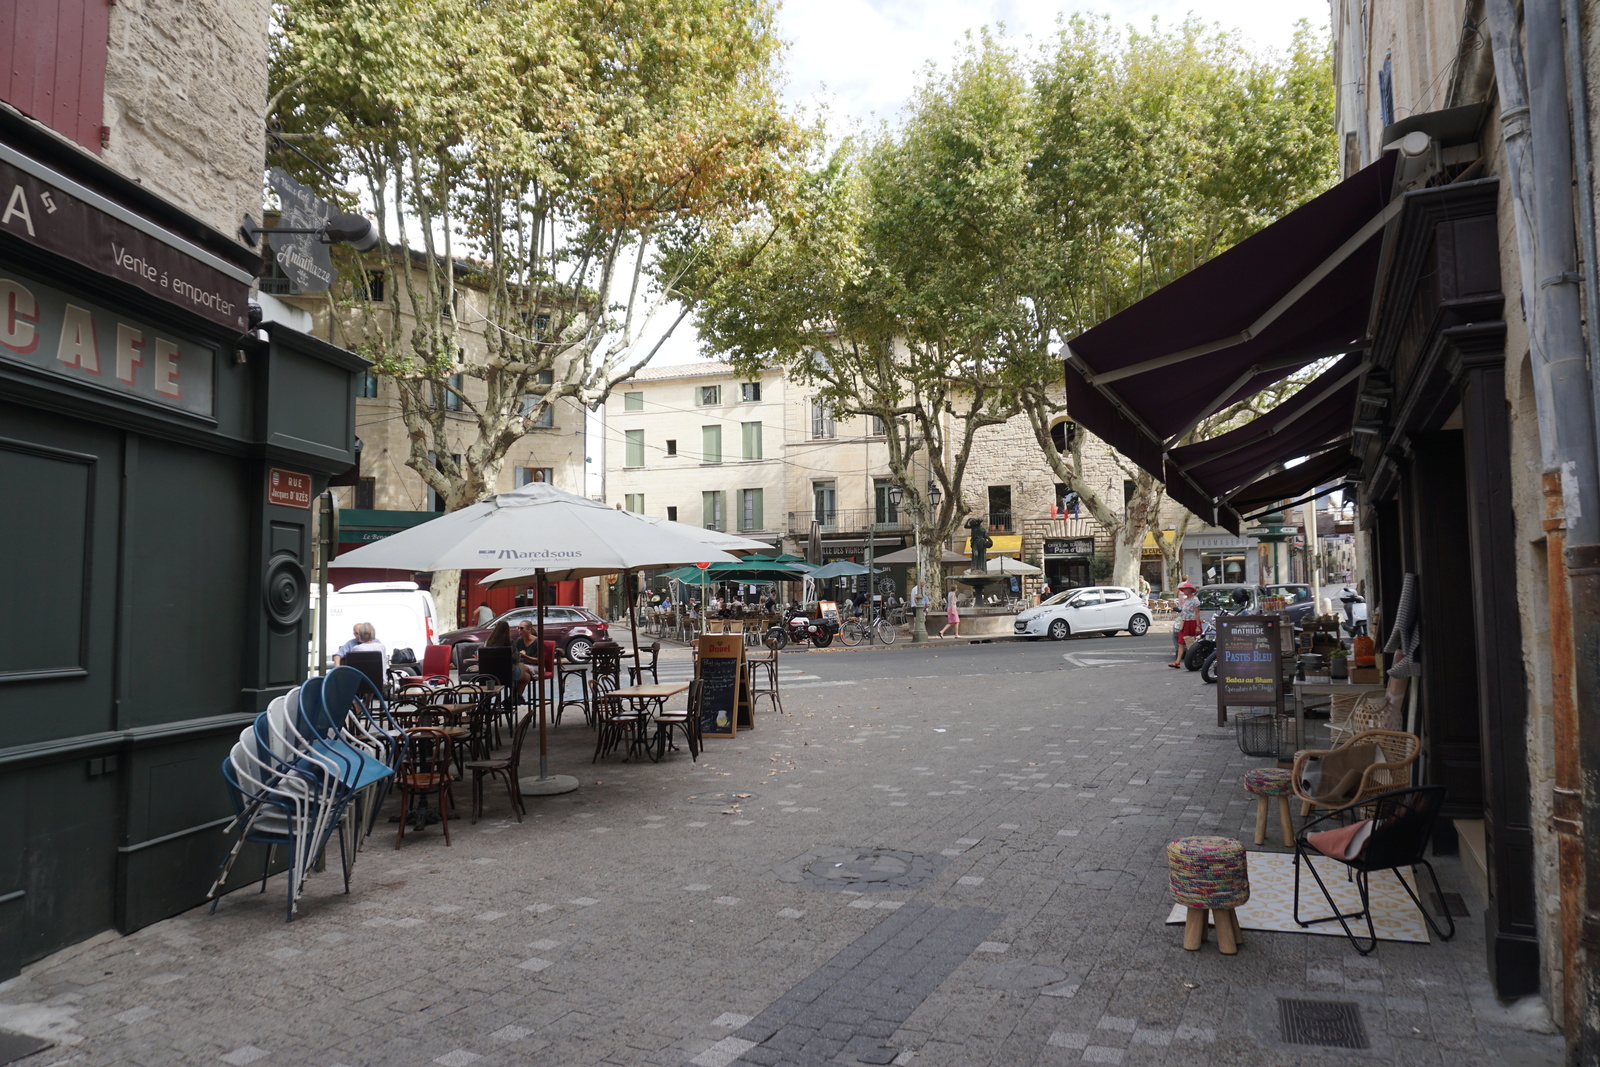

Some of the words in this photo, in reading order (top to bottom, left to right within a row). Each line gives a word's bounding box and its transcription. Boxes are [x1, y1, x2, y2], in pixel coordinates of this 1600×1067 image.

[111, 242, 157, 282] Vente
[173, 278, 235, 316] emporter
[0, 278, 181, 399] CAFE
[288, 477, 302, 488] RUE
[271, 488, 289, 500] Jacques
[1197, 538, 1249, 546] FROMAGERIE
[498, 549, 582, 559] Maredsous
[709, 644, 731, 653] Duvel
[1253, 651, 1272, 662] BLEU
